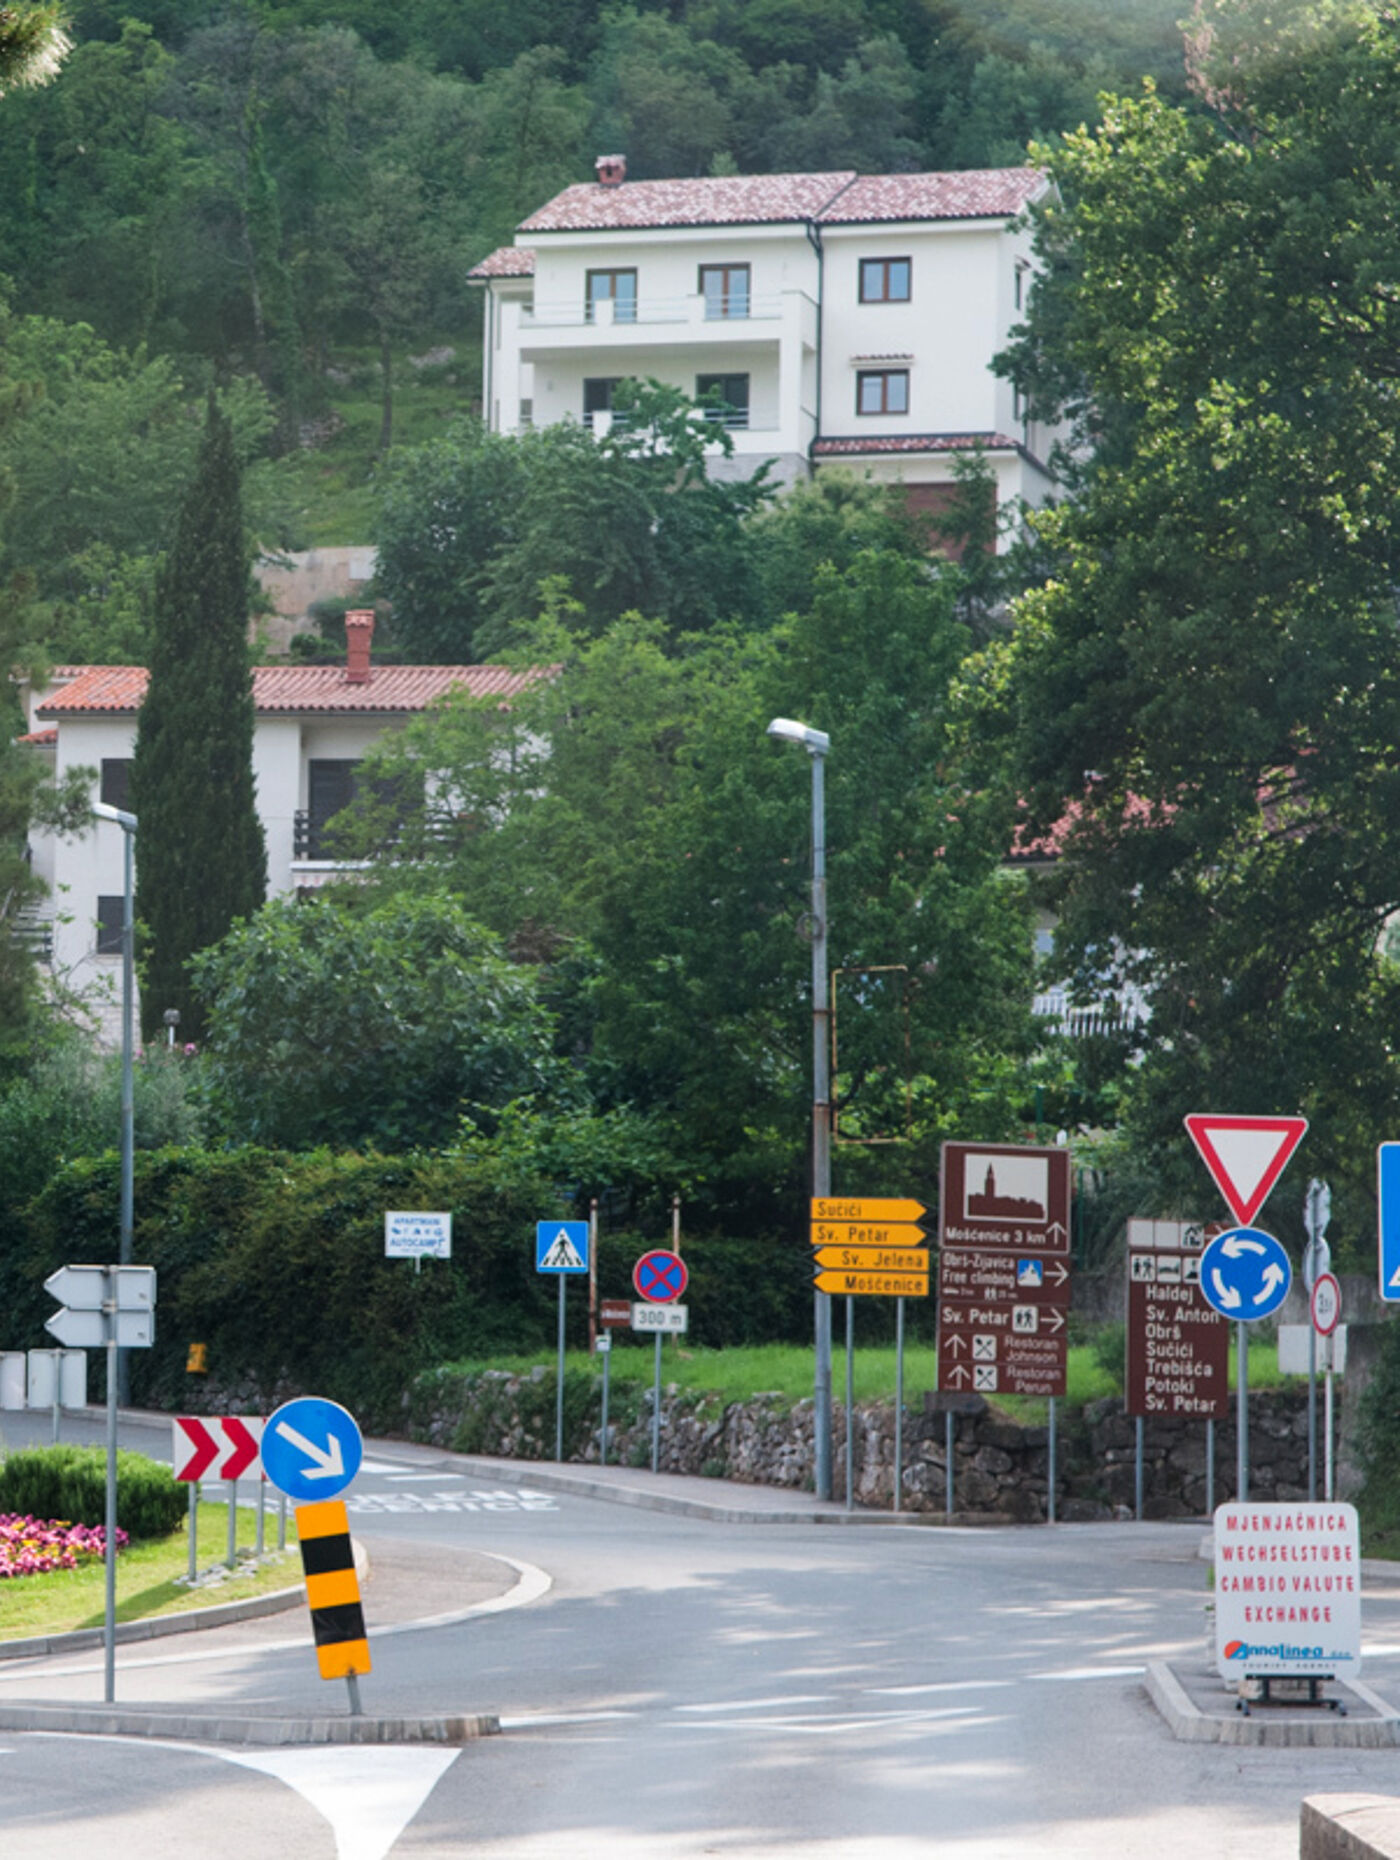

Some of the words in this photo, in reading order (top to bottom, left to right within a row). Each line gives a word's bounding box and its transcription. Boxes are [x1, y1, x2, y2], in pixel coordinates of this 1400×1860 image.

[817, 1225, 839, 1241] Sv.
[849, 1226, 889, 1242] Petar
[1014, 1229, 1023, 1243] 3
[1026, 1230, 1046, 1244] km
[842, 1250, 864, 1266] Sv.
[874, 1252, 923, 1268] Jelena
[942, 1269, 967, 1284] Free
[970, 1271, 1016, 1289] climbing
[1145, 1284, 1194, 1305] Haldej
[639, 1310, 666, 1325] 300
[671, 1314, 682, 1326] m
[942, 1306, 964, 1324] Sv.
[969, 1308, 1009, 1325] Petar
[1145, 1304, 1169, 1321] Sv.
[1174, 1306, 1219, 1324] Anton
[1004, 1335, 1059, 1350] Restoran
[1006, 1349, 1058, 1364] Johnson
[1006, 1365, 1062, 1380] Restoran
[1145, 1376, 1195, 1394] Potoki
[1145, 1393, 1168, 1410] Sv.
[1173, 1395, 1216, 1412] Petar
[1226, 1512, 1347, 1531] MJENJAČNICA
[1222, 1546, 1353, 1562] WECHSELSTUBE
[1221, 1576, 1287, 1592] CAMBIO
[1292, 1576, 1354, 1592] VALUTE
[1245, 1606, 1332, 1622] EXCHANGE
